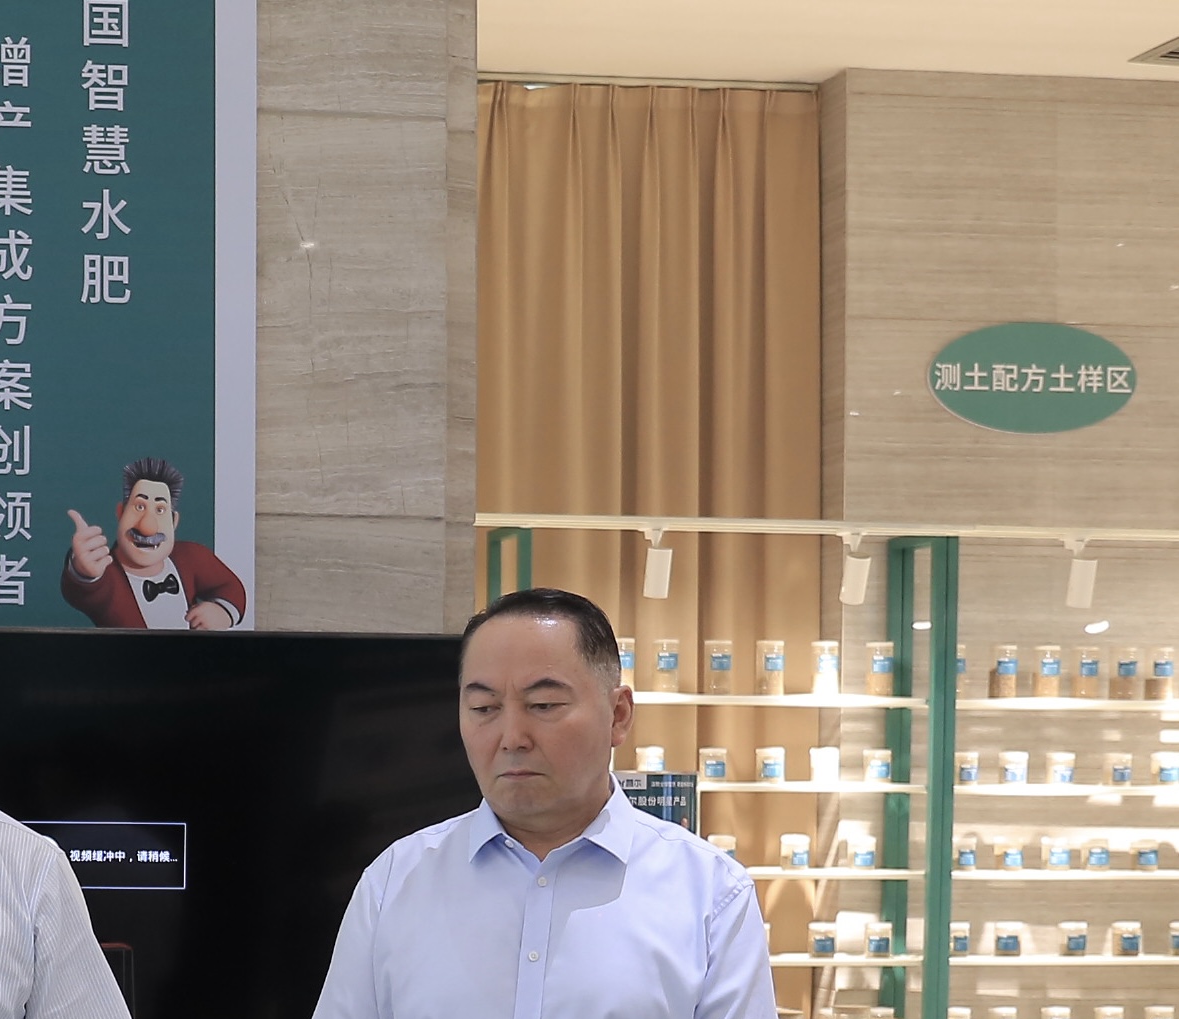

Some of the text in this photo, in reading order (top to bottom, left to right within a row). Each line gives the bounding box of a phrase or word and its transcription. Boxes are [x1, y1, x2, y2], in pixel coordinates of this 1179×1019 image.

[80, 0, 131, 304] 国智慧水肥
[934, 362, 1133, 394] 测土配方土样区
